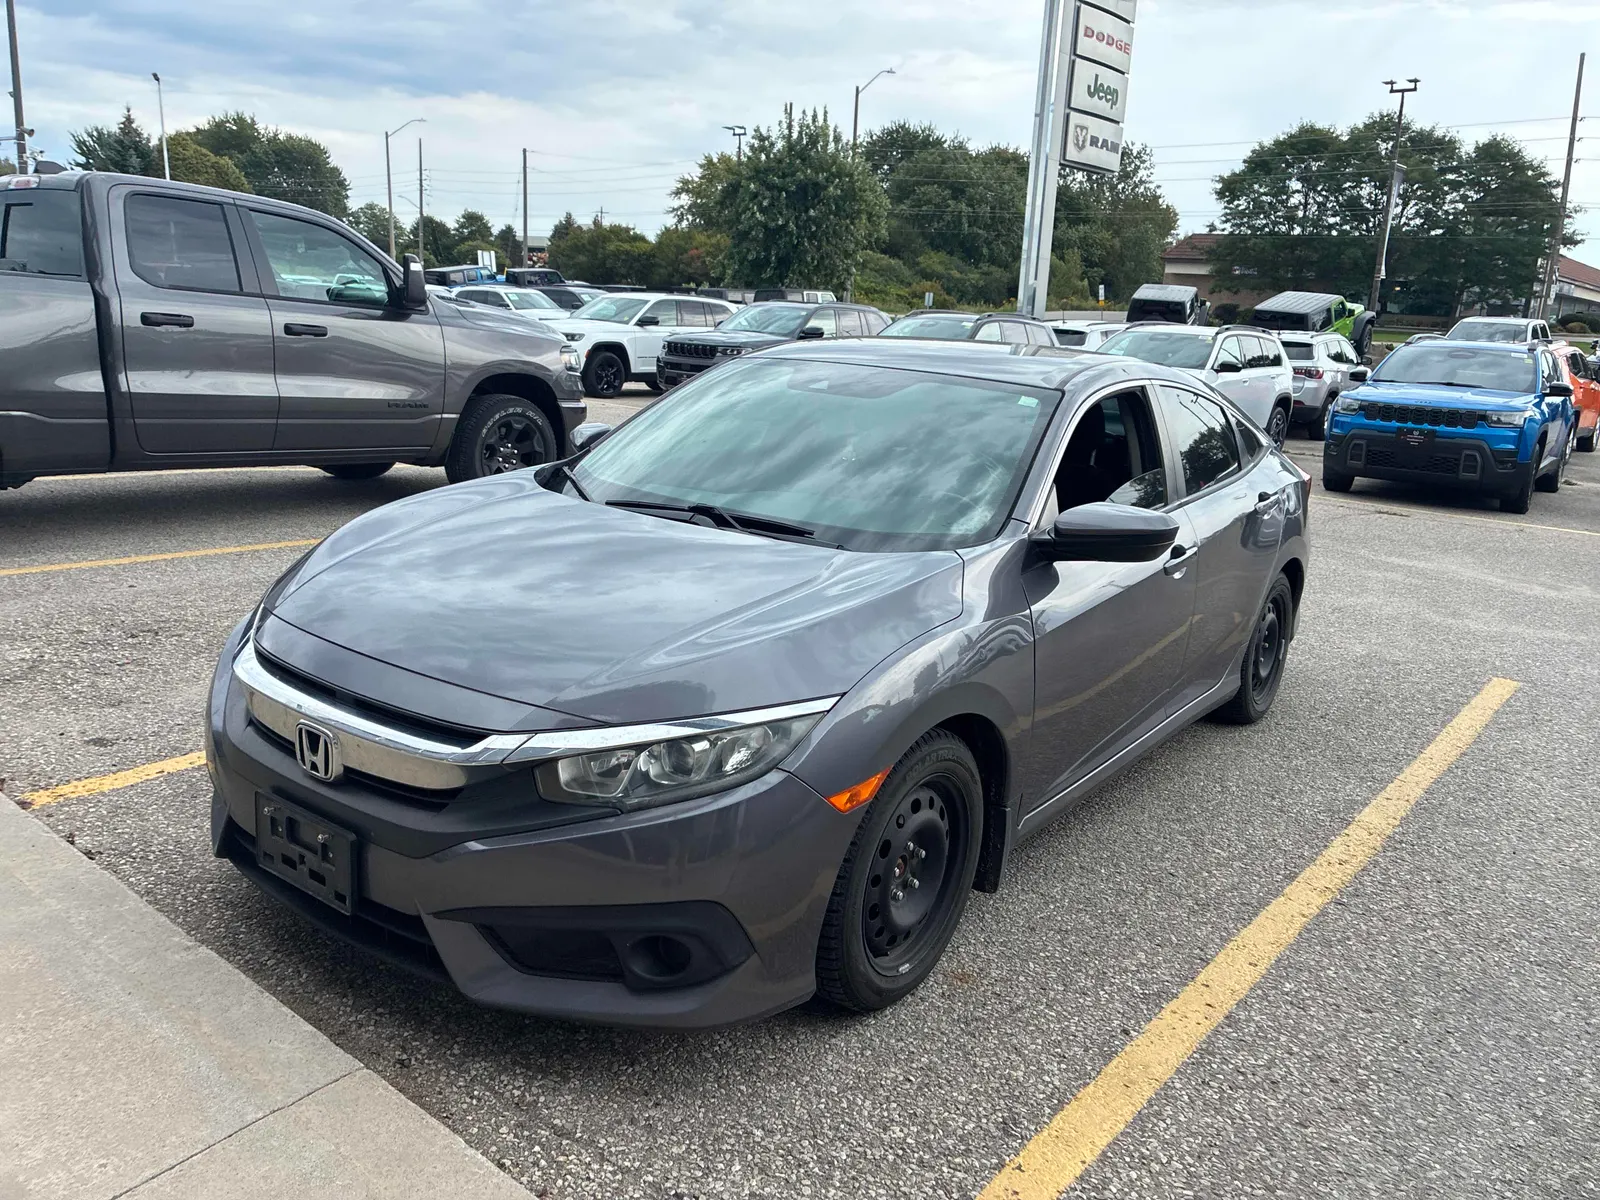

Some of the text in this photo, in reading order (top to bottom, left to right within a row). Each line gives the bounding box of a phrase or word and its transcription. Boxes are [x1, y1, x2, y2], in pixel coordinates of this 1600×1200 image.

[1083, 25, 1131, 55] DODGE
[1087, 73, 1119, 109] Jeep
[1089, 134, 1120, 155] RAM
